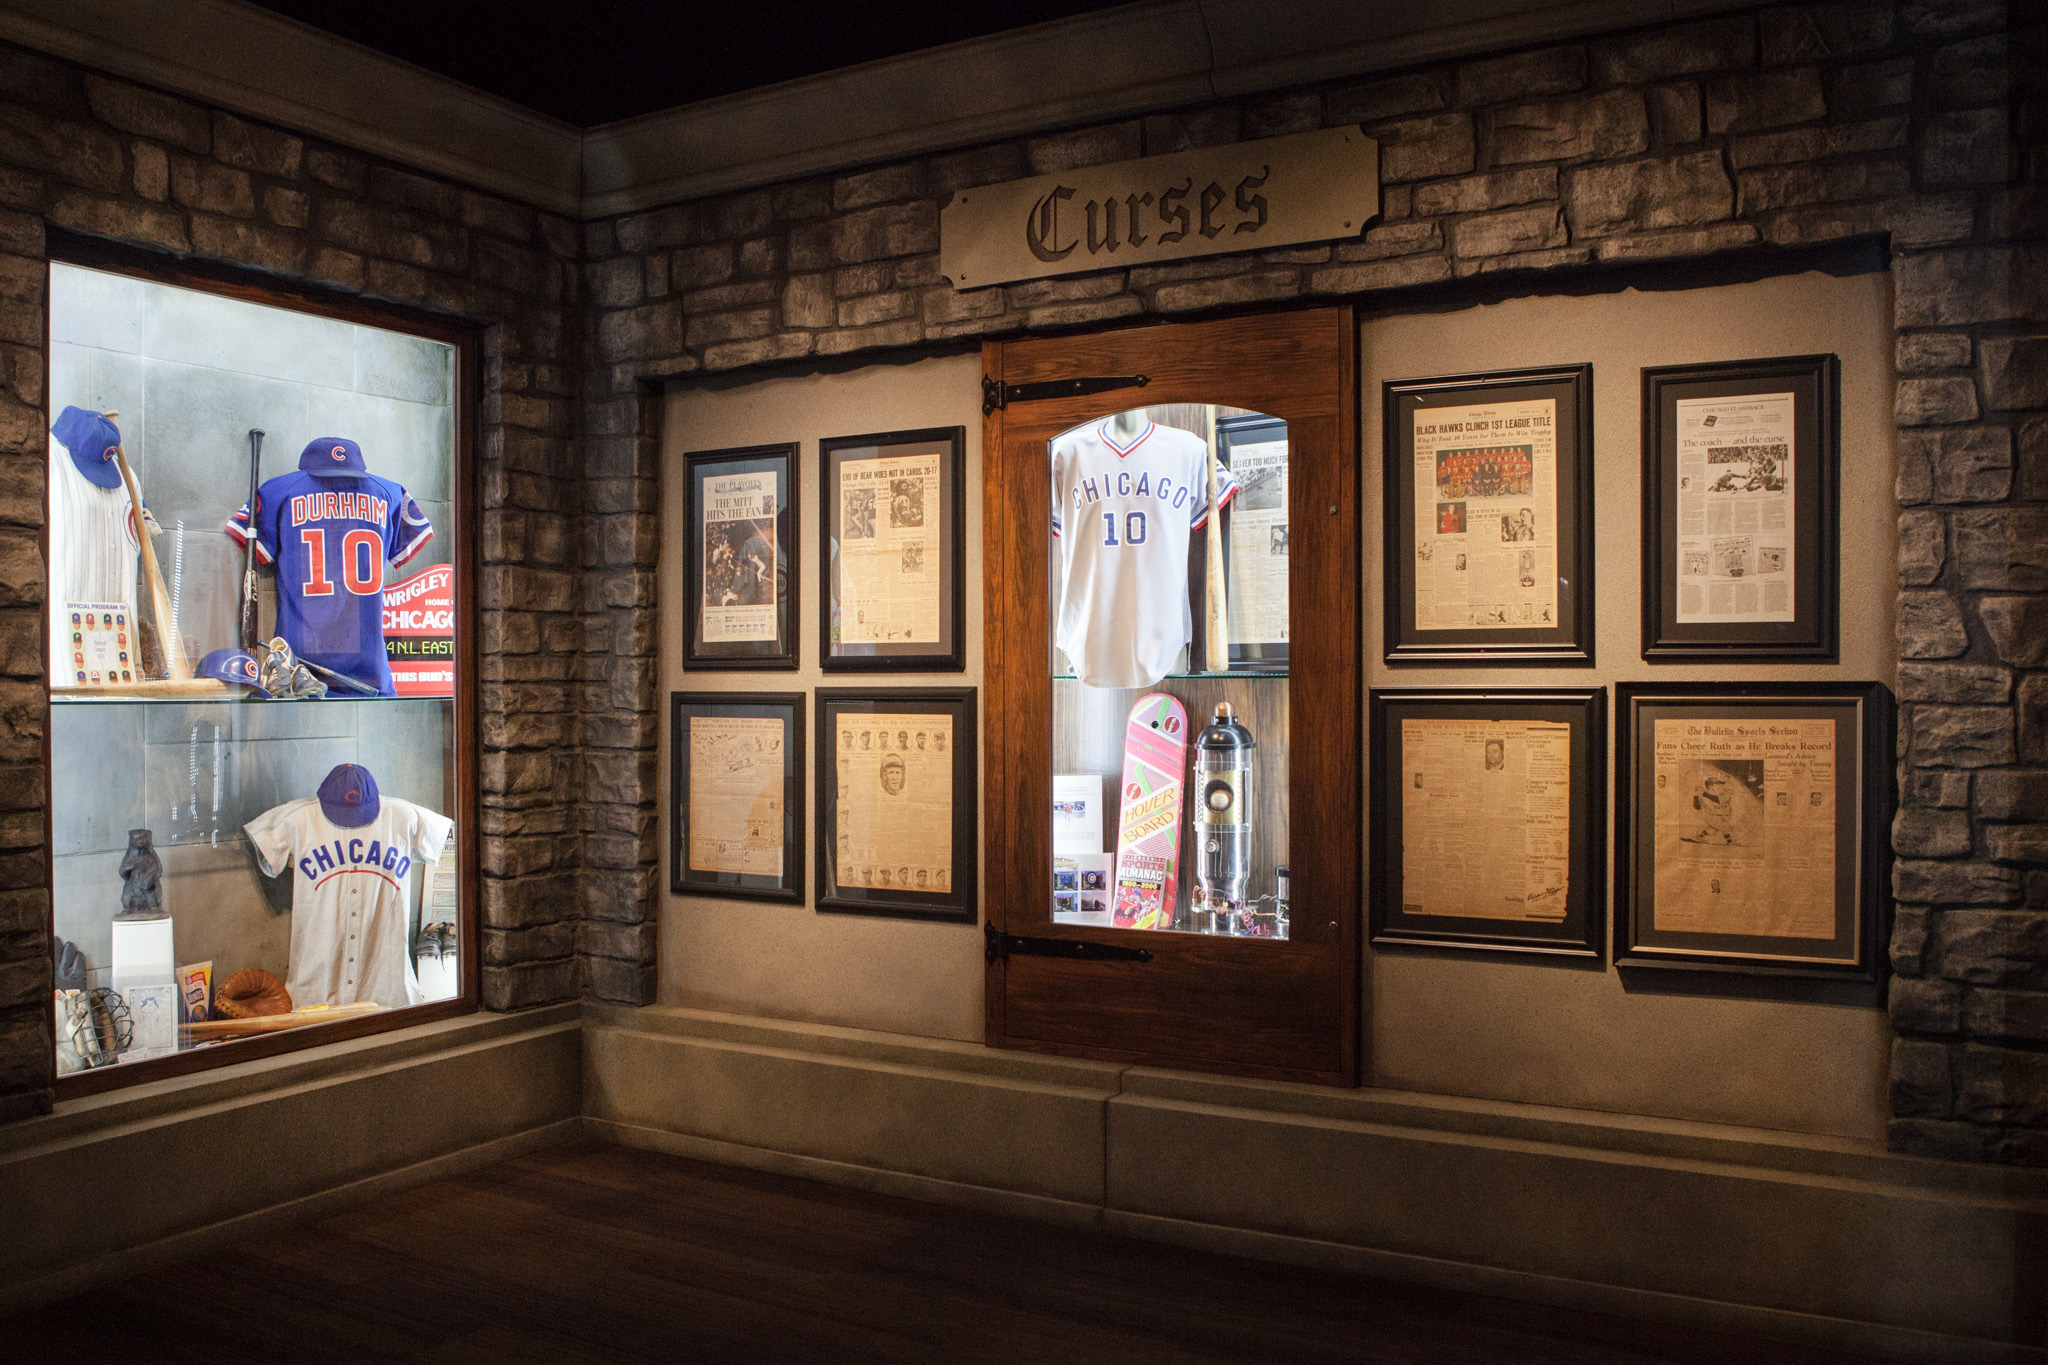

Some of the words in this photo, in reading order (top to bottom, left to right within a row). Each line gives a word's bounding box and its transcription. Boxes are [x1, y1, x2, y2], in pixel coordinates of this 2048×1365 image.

[1026, 165, 1269, 262] Curses
[1416, 425, 1437, 436] BLACK
[1439, 423, 1464, 433] HAWKS
[1466, 421, 1489, 431] CLINCH
[1491, 420, 1503, 430] 1ST
[1505, 418, 1531, 429] LEAGUE
[1532, 416, 1552, 427] TITLE
[1682, 440, 1698, 448] The
[1699, 438, 1723, 447] coach
[1733, 436, 1747, 445] and
[1764, 435, 1786, 443] curse
[1071, 471, 1189, 510] CHICAGO
[291, 492, 388, 528] DURHAM
[715, 499, 731, 509] THE
[733, 497, 754, 508] MITT
[706, 510, 726, 521] HITS
[728, 508, 744, 519] THE
[746, 507, 762, 518] FAN
[1101, 510, 1147, 548] 10
[301, 528, 384, 597] 10
[382, 573, 449, 607] WRIGLEY
[397, 642, 420, 654] N.L.
[422, 641, 453, 655] EAST
[391, 672, 417, 682] THIS
[419, 670, 453, 682] BUD'S
[1687, 725, 1702, 735] The
[1656, 741, 1677, 750] Fans
[1681, 741, 1706, 750] Cheer
[1710, 742, 1732, 750] Ruth
[1748, 742, 1761, 750] He
[1765, 742, 1796, 750] Breaks
[1800, 741, 1832, 750] Record
[1125, 787, 1175, 825] HOVER
[1123, 811, 1175, 843] BOARD
[299, 838, 411, 881] CHICAGO
[1121, 860, 1165, 872] SPORTS
[1120, 868, 1164, 882] ALMANAC
